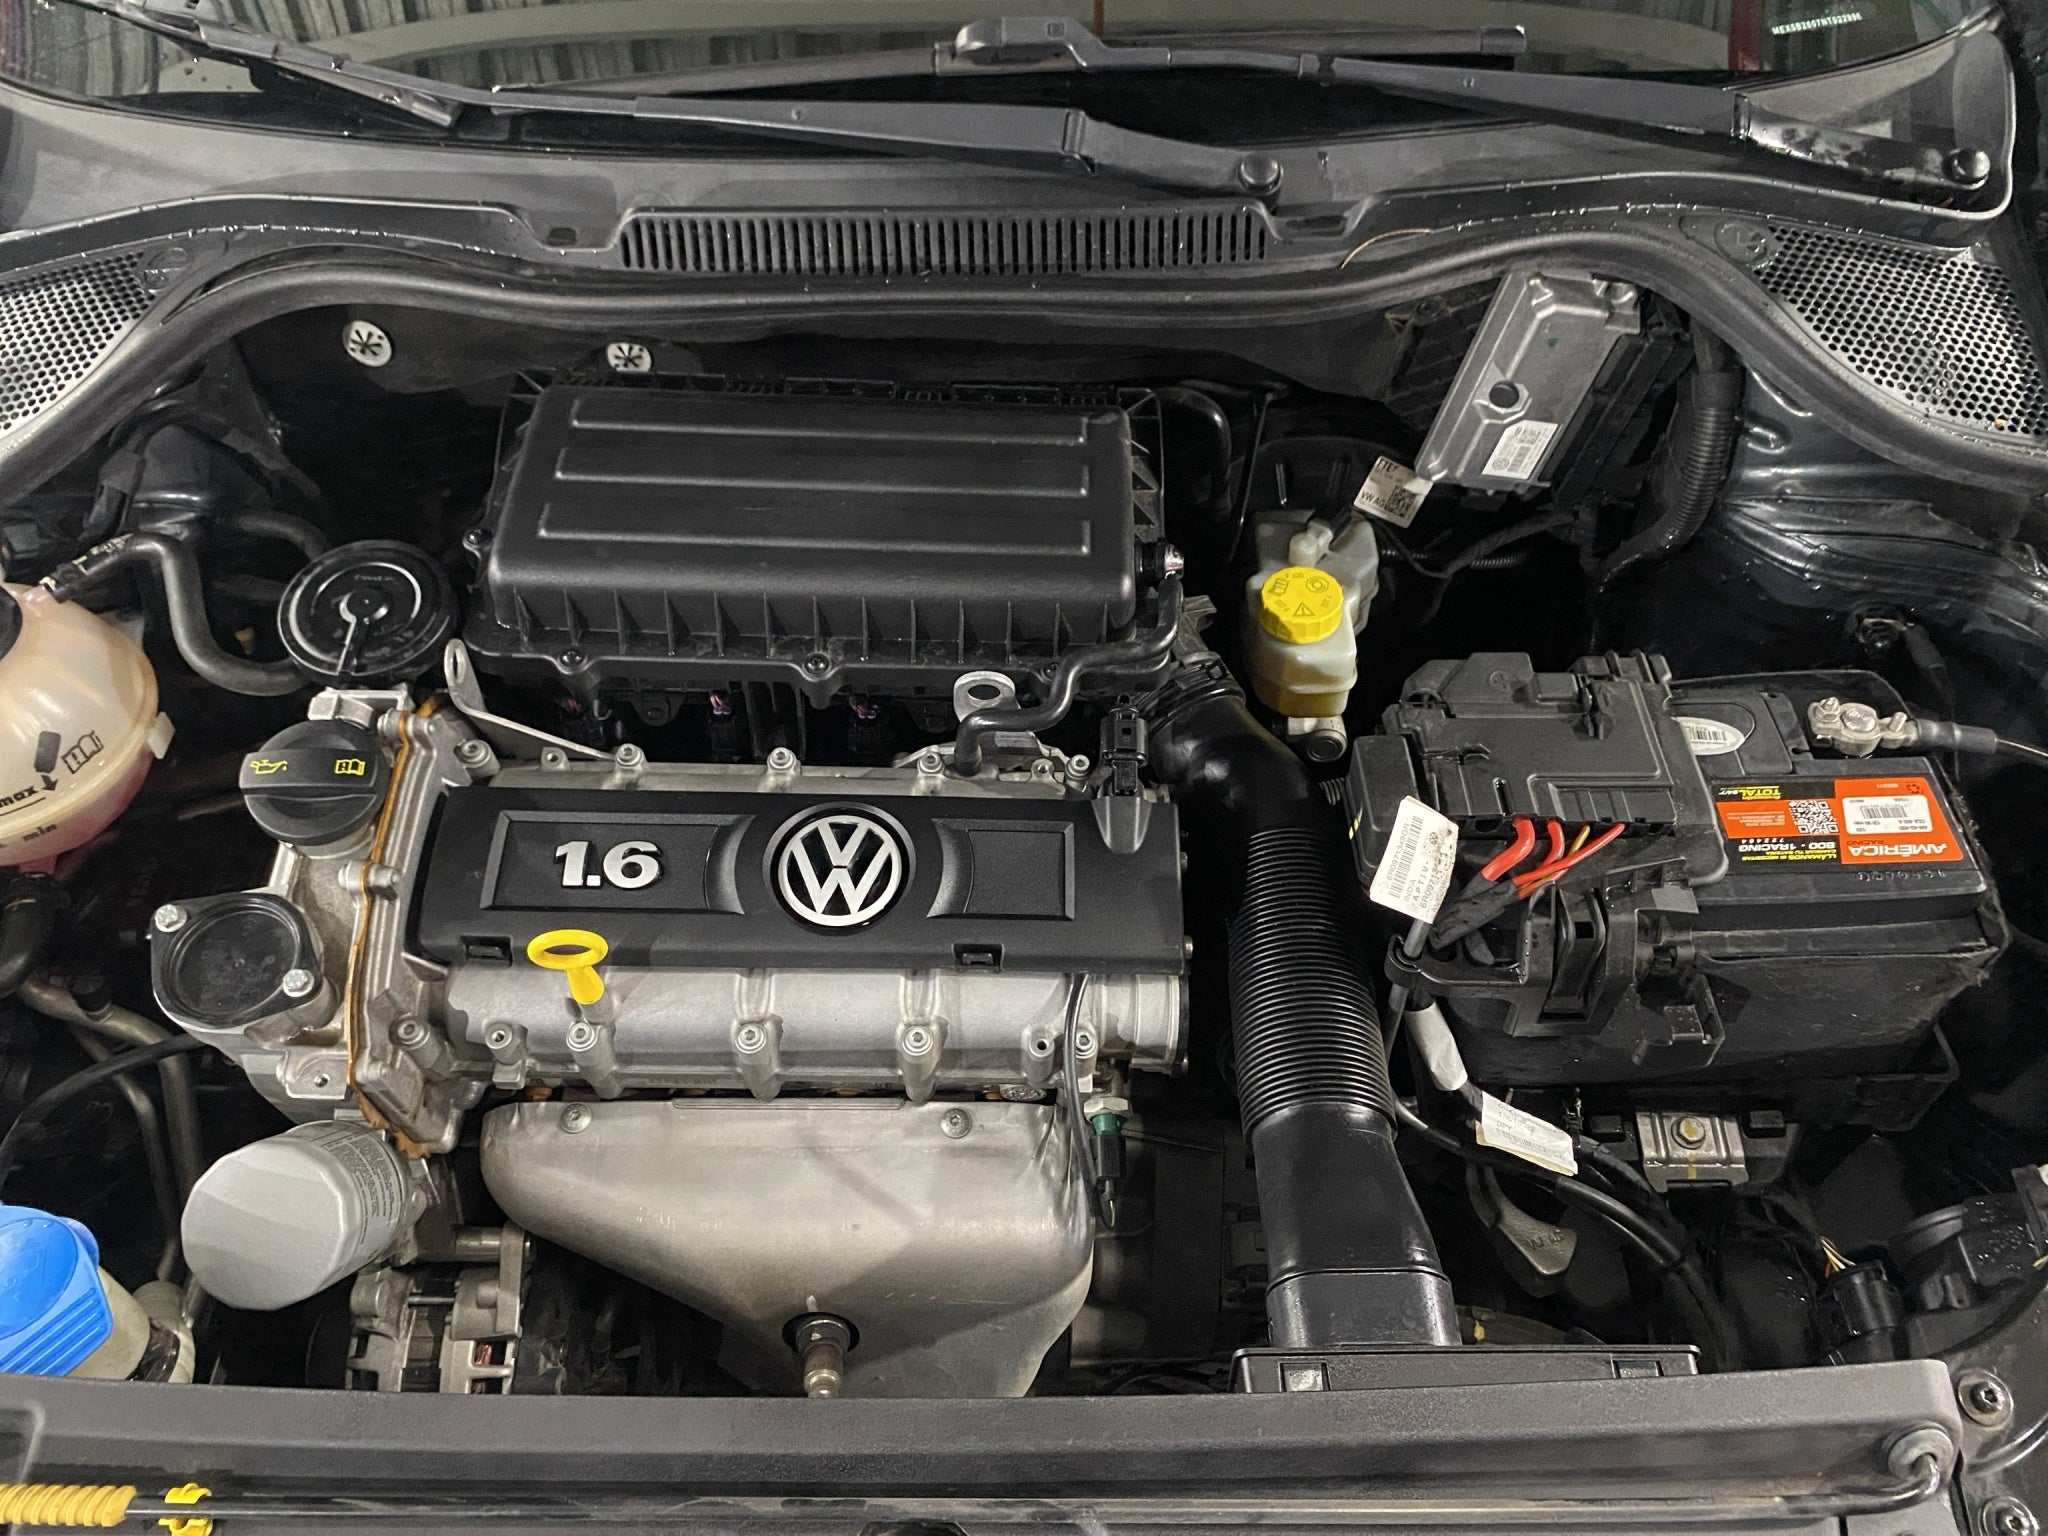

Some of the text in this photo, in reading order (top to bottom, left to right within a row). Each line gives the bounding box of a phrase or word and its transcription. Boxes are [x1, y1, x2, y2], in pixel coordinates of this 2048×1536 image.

[1739, 788, 1781, 797] TOTAL
[23, 824, 57, 841] min
[1739, 843, 1797, 852] 1RACING
[1848, 843, 1948, 857] AMÉRICA
[554, 840, 661, 889] 1.6
